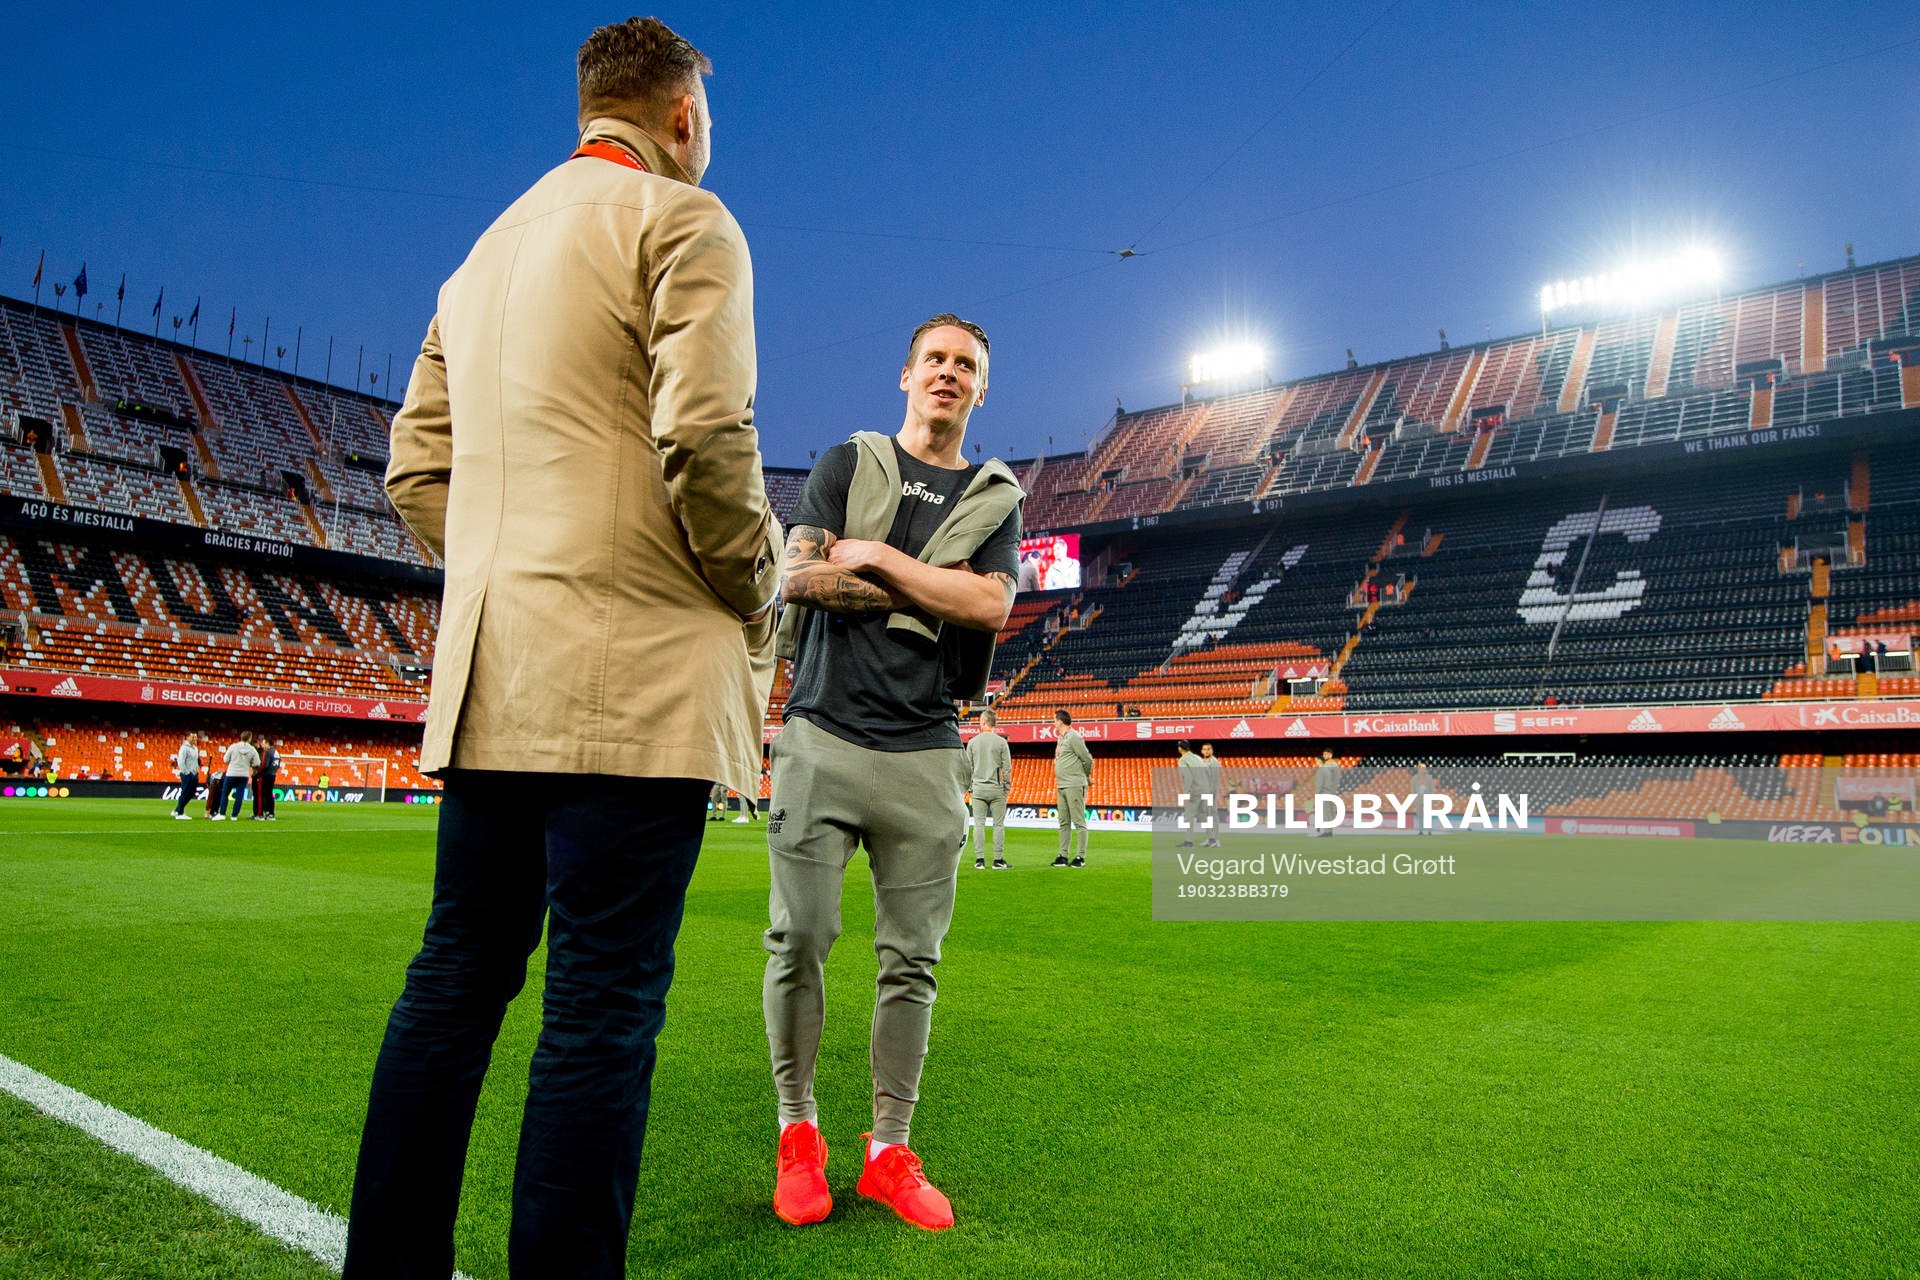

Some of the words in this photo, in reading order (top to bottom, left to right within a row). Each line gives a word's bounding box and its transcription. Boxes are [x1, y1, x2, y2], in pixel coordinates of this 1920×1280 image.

[1684, 439, 1704, 453] WE
[1707, 433, 1748, 451] THANK
[1750, 430, 1778, 445] OUR
[1782, 424, 1820, 440] FANS!
[1429, 476, 1451, 488] THIS
[1454, 474, 1464, 484] IS
[1467, 466, 1517, 482] MESTALLA
[1265, 499, 1283, 511] 1971
[21, 502, 48, 519] AÇÒ
[52, 505, 69, 520] ÉS
[73, 510, 134, 531] MESTALLA
[1143, 516, 1159, 527] 1967
[204, 532, 251, 550] GRÀCIES
[254, 541, 294, 558] AFICIÓ!
[161, 689, 232, 705] SELECCIÓN
[235, 695, 296, 709] ESPAÑOLA
[299, 700, 313, 710] DE
[315, 701, 355, 714] FÚTBOL
[1156, 725, 1195, 734] SEAT
[1372, 718, 1440, 734] CaixaBank
[1521, 716, 1578, 727] SEAT
[1003, 807, 1038, 820] UEFA
[1578, 823, 1626, 834] EUROPEAN
[1627, 824, 1680, 836] QUALIFIERS
[1767, 825, 1836, 844] UEFA
